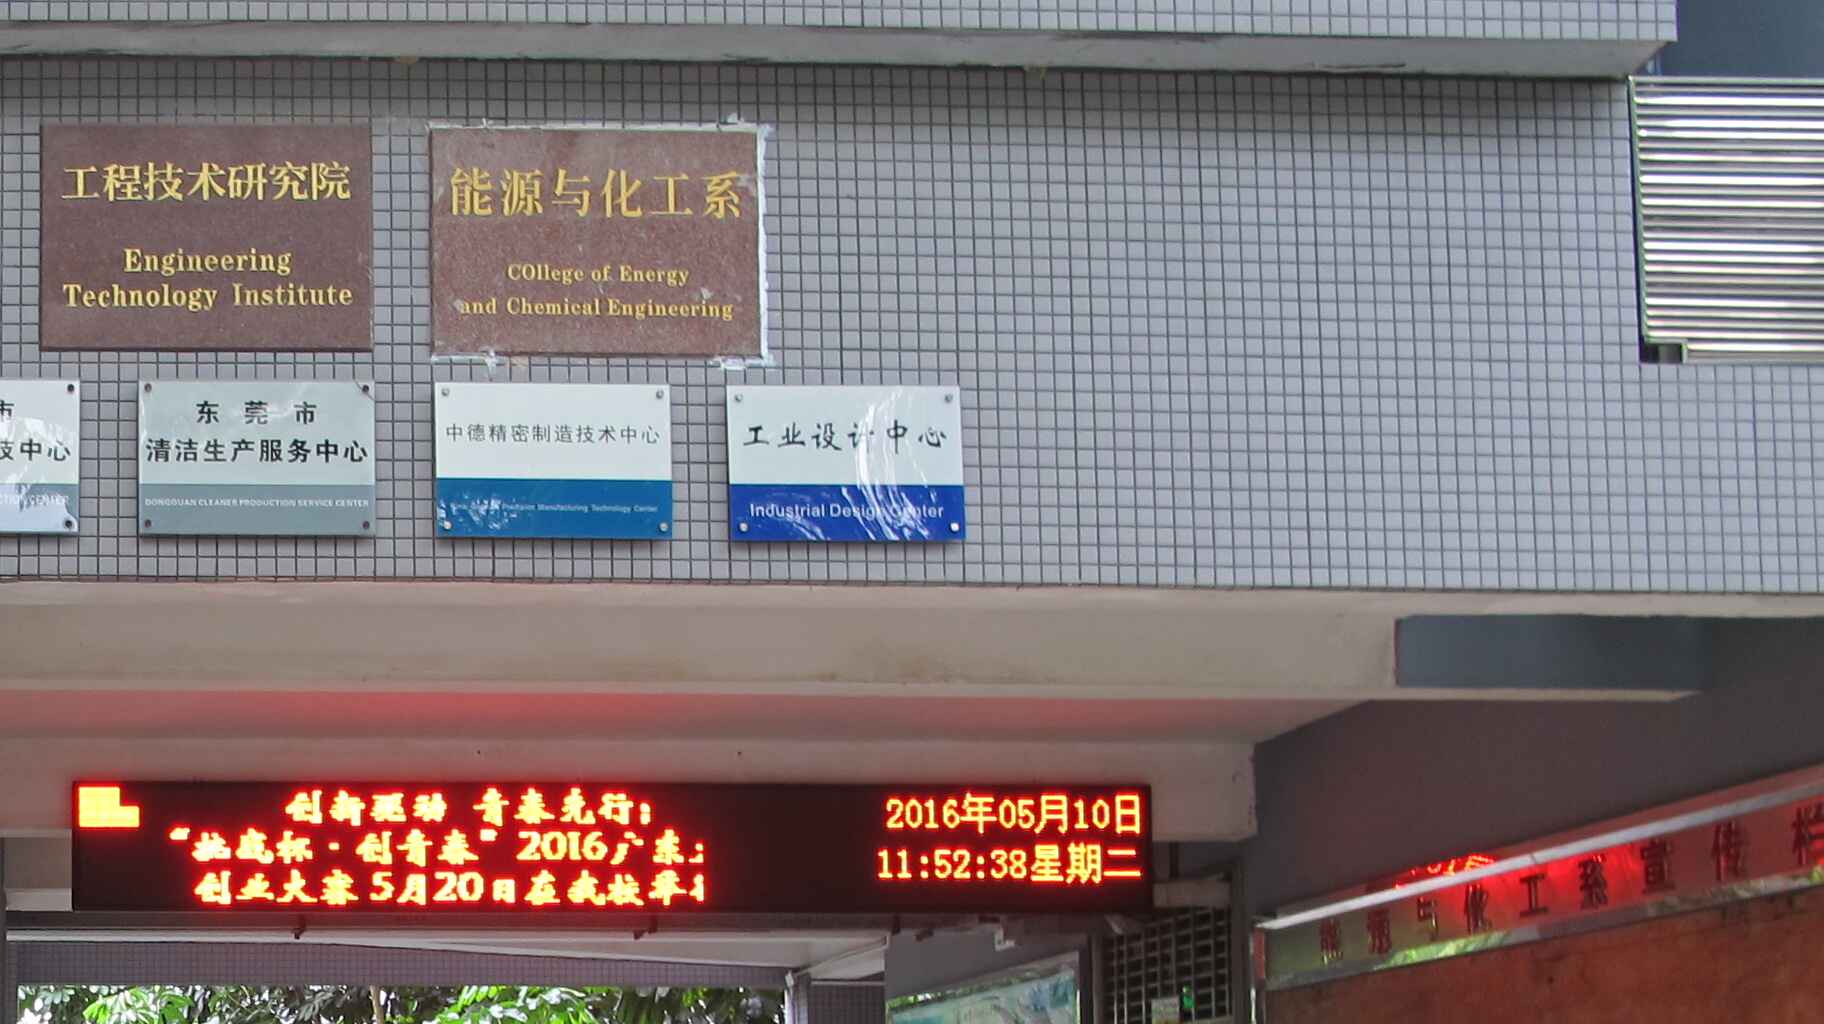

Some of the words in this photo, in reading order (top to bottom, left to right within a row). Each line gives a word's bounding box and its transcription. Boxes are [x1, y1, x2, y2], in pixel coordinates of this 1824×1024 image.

[61, 161, 351, 201] 工程技术研究院
[450, 167, 743, 220] 能源与化工系
[124, 248, 292, 276] Engineering
[591, 264, 611, 282] of
[620, 265, 689, 286] Energy
[63, 284, 217, 311] Technology
[232, 283, 353, 306] Institute
[459, 297, 497, 315] and
[507, 297, 600, 316] Chemical
[608, 297, 734, 321] Engineering
[196, 401, 317, 424] 东莞市
[446, 423, 660, 444] 中德精密制造技术中心
[743, 420, 947, 455] 工业设计中心
[146, 438, 368, 463] 清洁生产服务中心
[145, 498, 197, 507] DONGGUAN
[198, 498, 237, 507] CLEANER
[239, 498, 296, 507] PRODUCTION
[298, 499, 333, 507] SERVICE
[335, 499, 369, 507] CENTER
[749, 503, 825, 518] Industrial
[885, 791, 1141, 834] 2016年05月10日
[877, 842, 1142, 884] 11:52:38星期二
